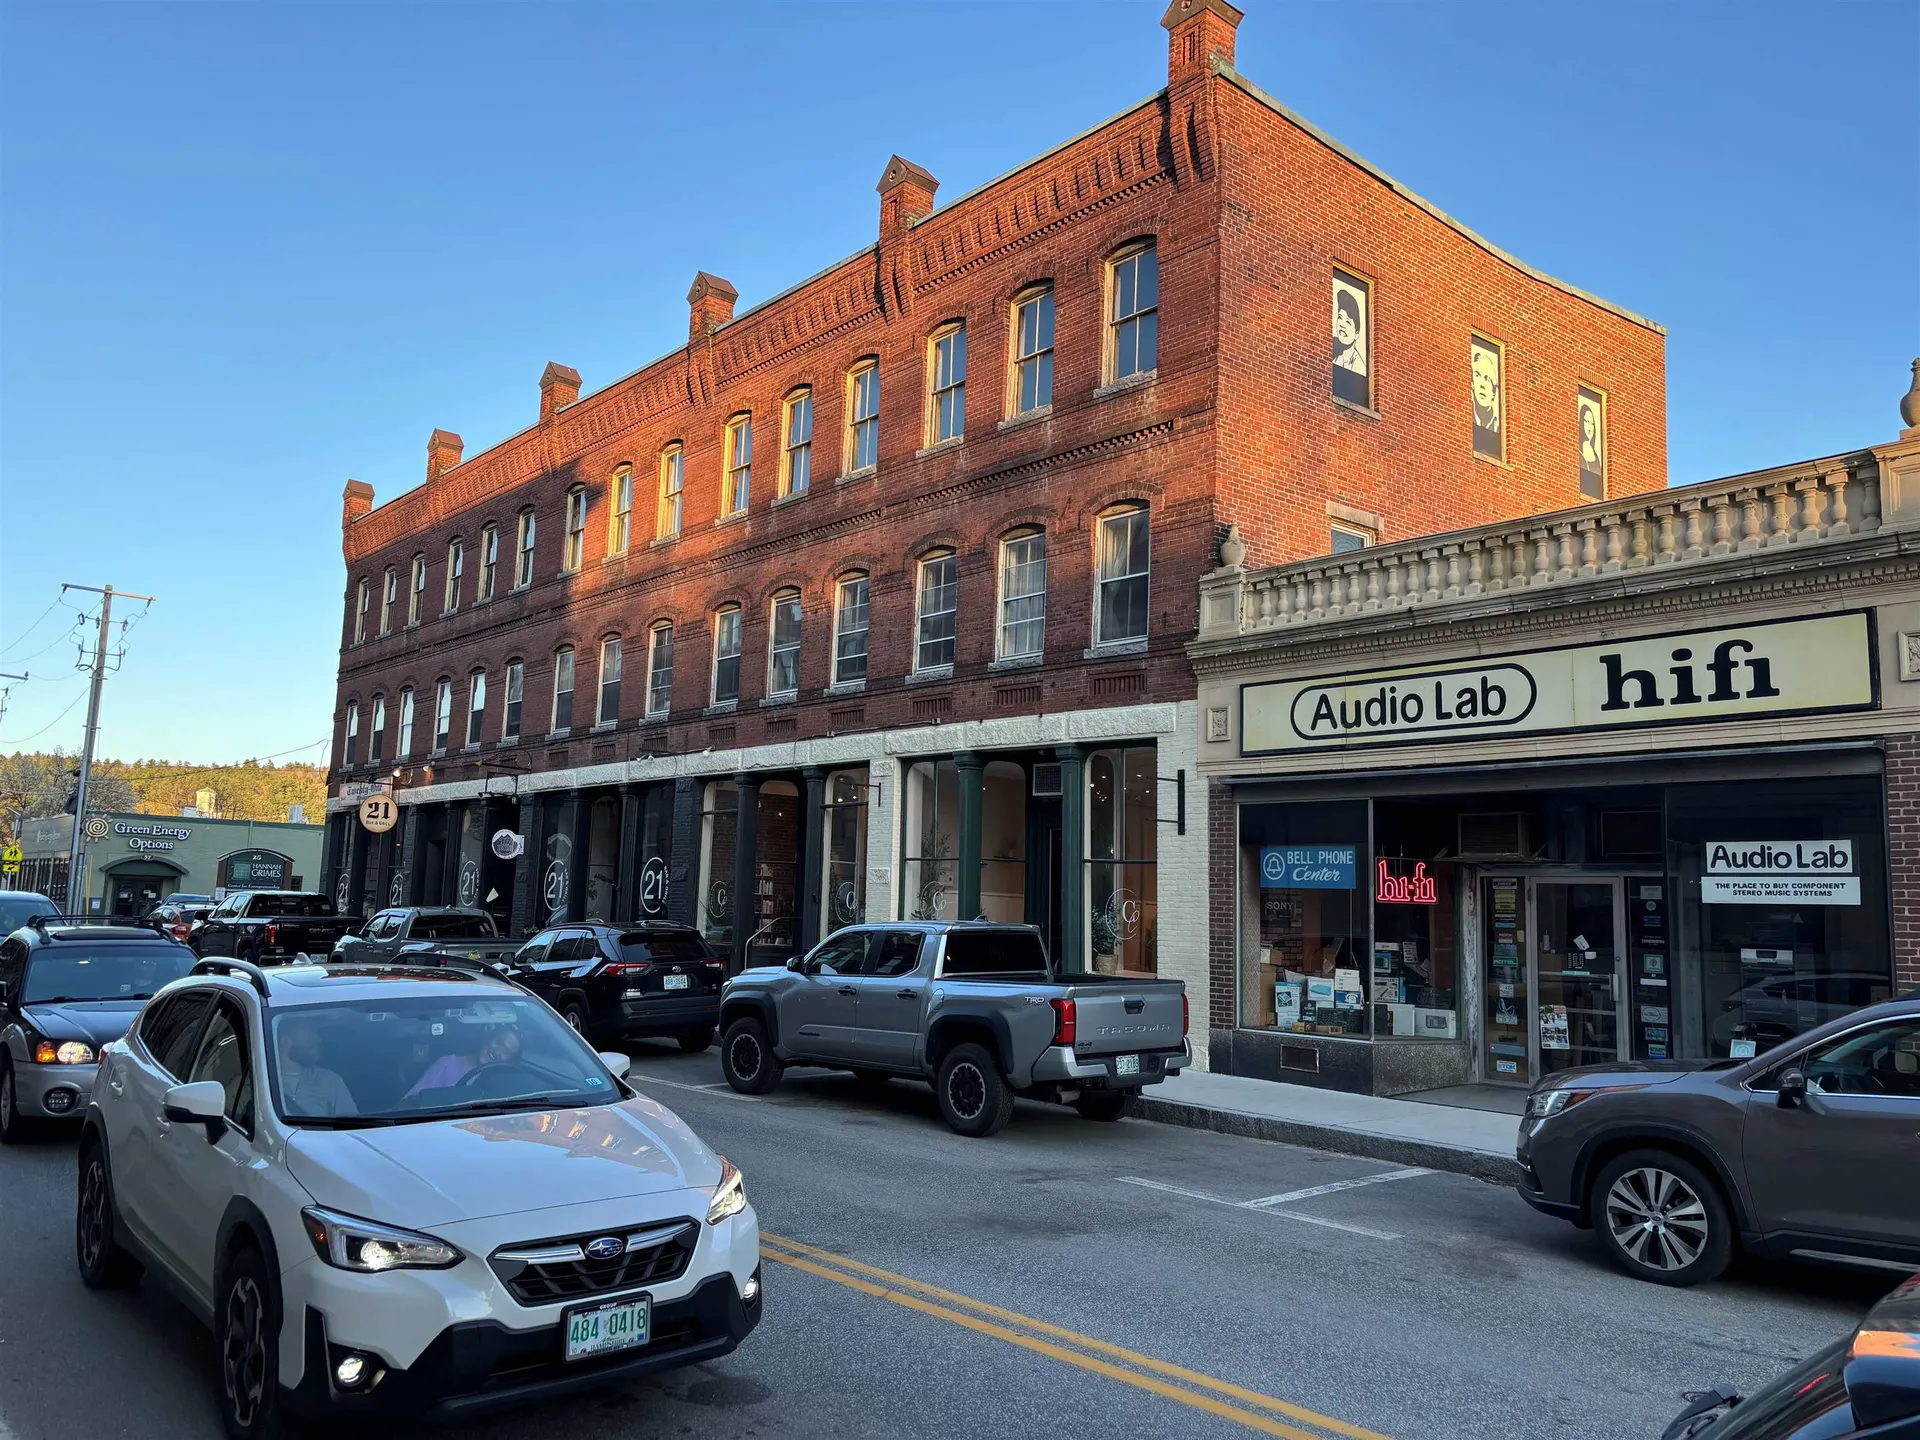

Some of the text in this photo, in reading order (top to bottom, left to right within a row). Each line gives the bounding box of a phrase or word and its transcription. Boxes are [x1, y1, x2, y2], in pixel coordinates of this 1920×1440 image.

[1600, 639, 1780, 711] hifi
[1310, 675, 1507, 731] Audio Lab
[367, 801, 390, 819] 21
[114, 822, 191, 840] Green Energy
[129, 837, 174, 851] Options
[1287, 850, 1353, 865] BELL PHONE
[1710, 843, 1849, 869] Audio Lab
[251, 869, 281, 878] GRIMES
[462, 871, 476, 895] 21
[1292, 866, 1341, 882] Center
[339, 882, 349, 902] 21
[391, 883, 403, 906] 21
[547, 872, 564, 899] 21
[644, 870, 663, 900] 21
[1266, 901, 1294, 910] SONY
[1024, 996, 1045, 1004] TRD
[1096, 1024, 1171, 1035] TACOMA
[570, 1317, 599, 1343] 484
[609, 1308, 646, 1335] 0418
